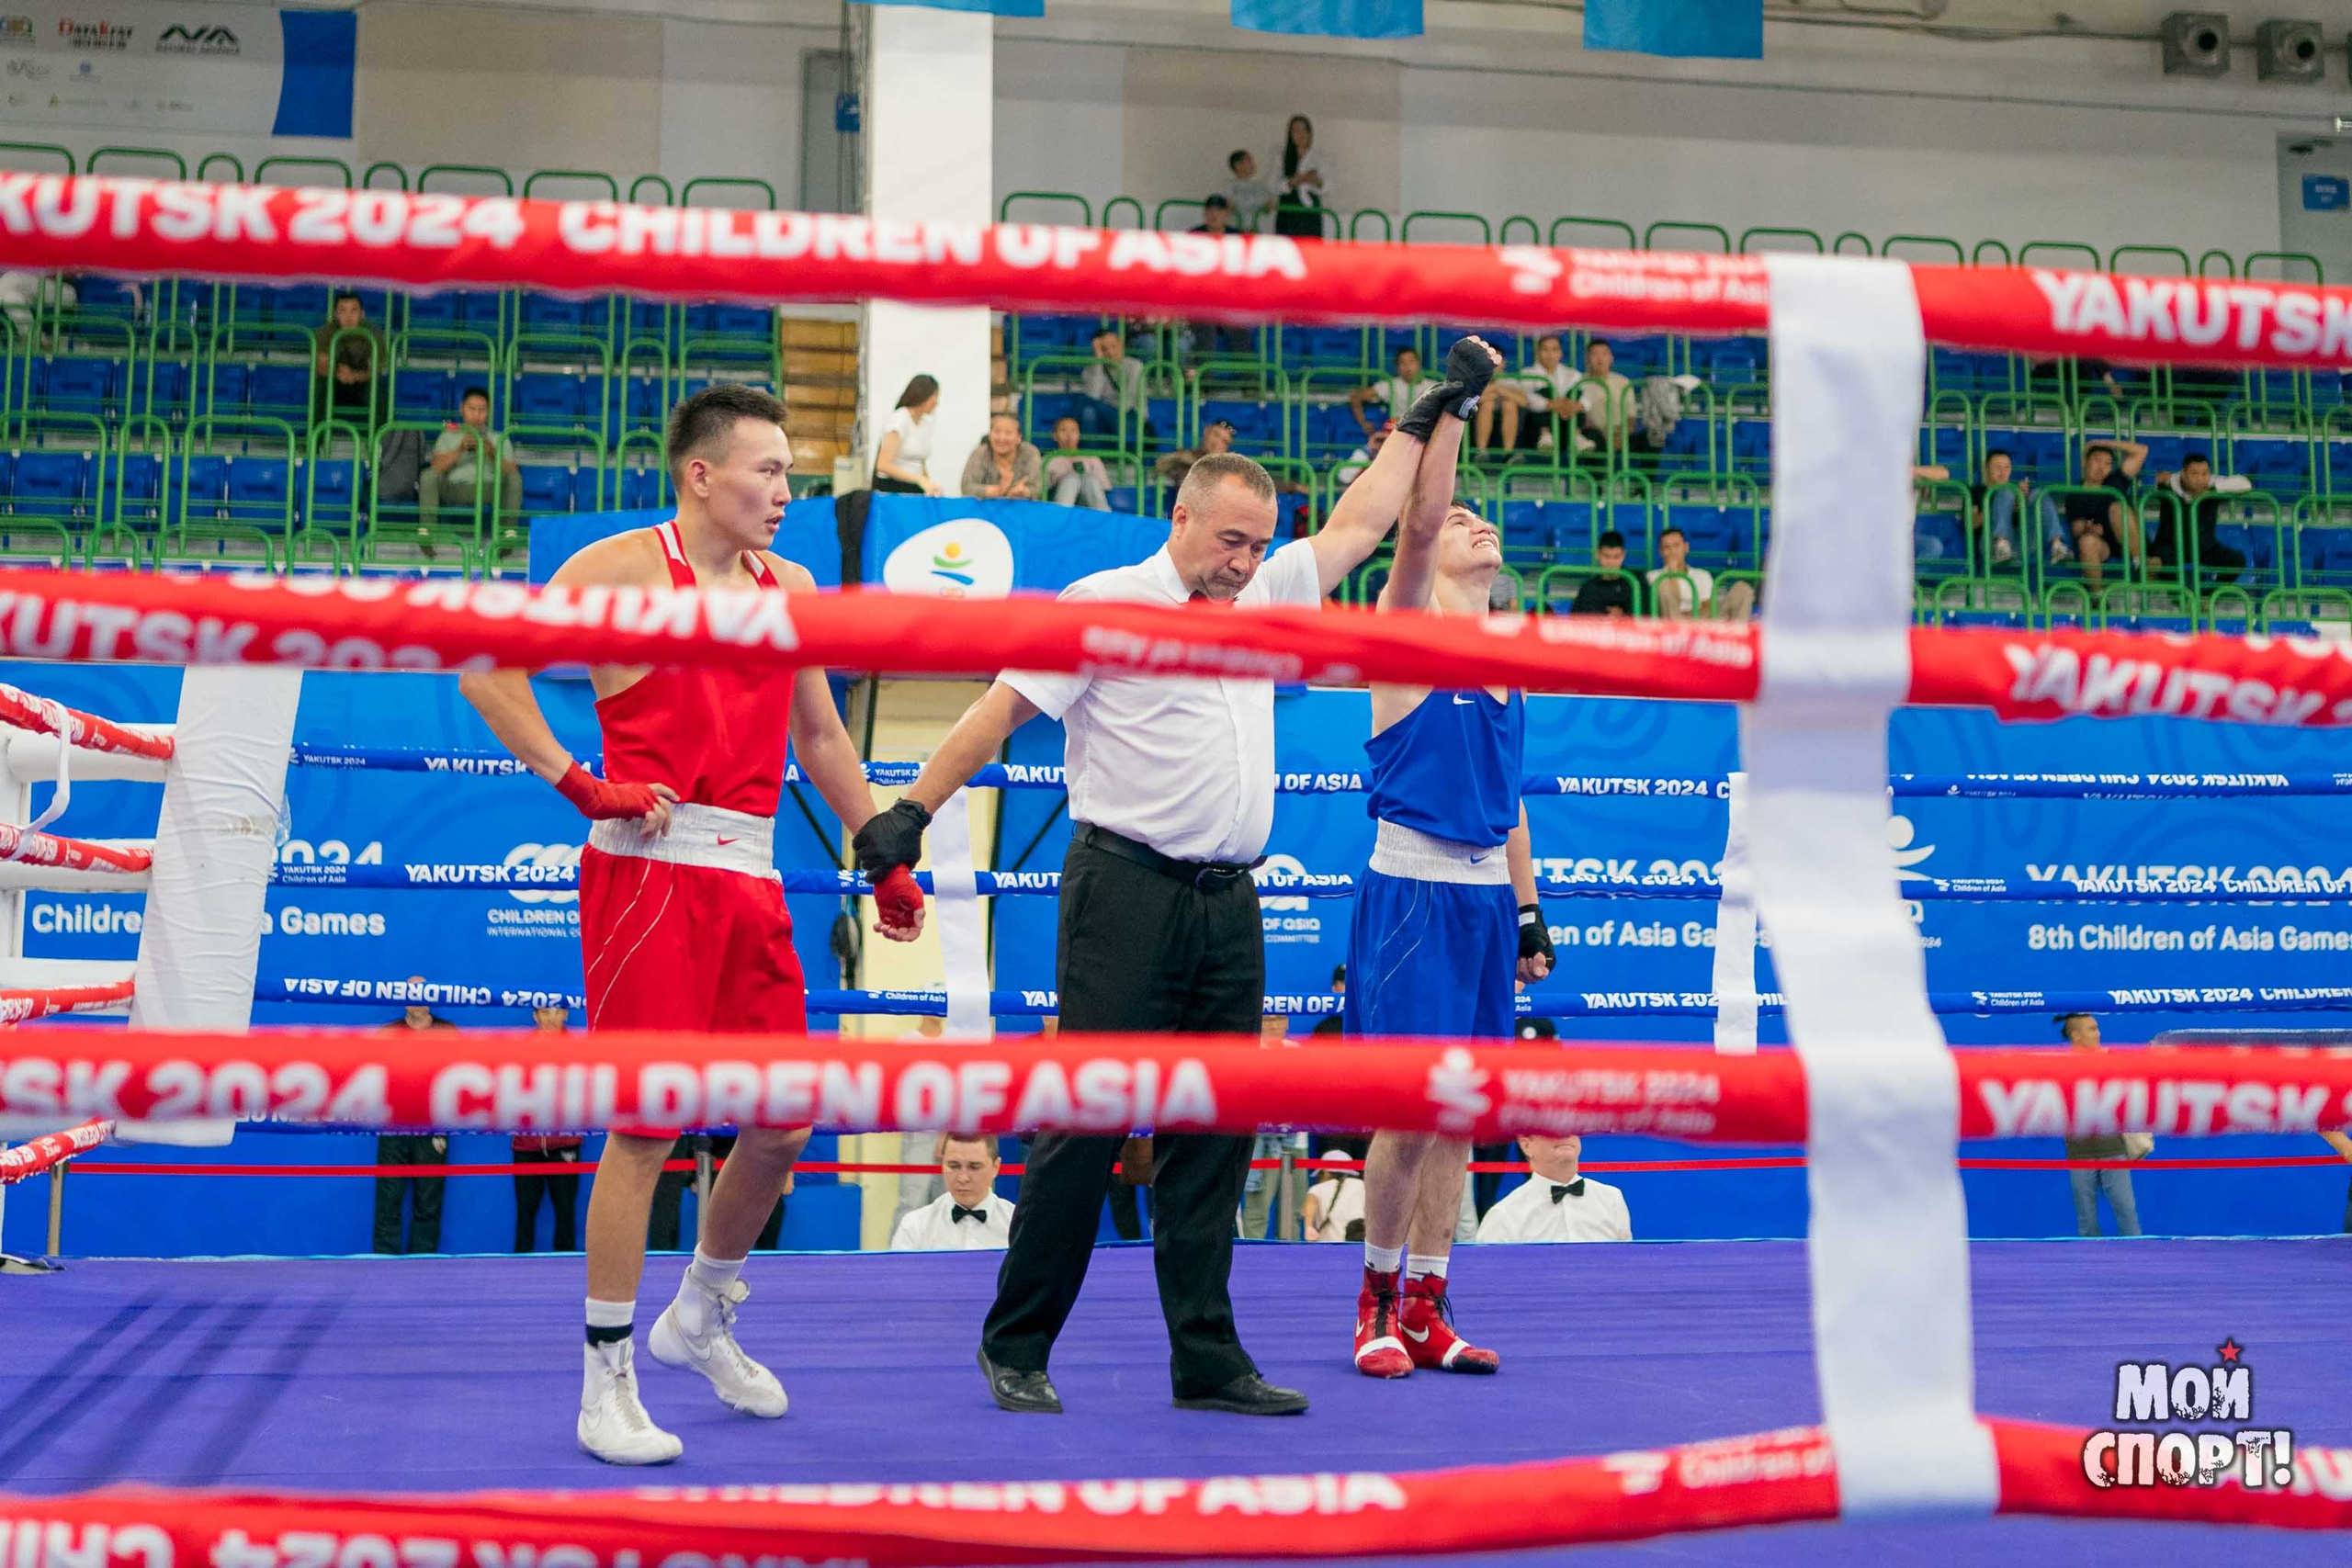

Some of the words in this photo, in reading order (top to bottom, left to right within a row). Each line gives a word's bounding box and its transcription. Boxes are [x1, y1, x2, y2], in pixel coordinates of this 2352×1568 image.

[289, 189, 526, 248] 2024
[558, 201, 984, 265] CHILDREN
[1108, 231, 1307, 279] ASIA
[874, 768, 912, 778] YAKUTSK
[1284, 773, 1312, 790] OF
[1314, 773, 1363, 790] ASIA
[1556, 776, 1651, 795] YAKUTSK
[1654, 779, 1709, 796] 2024
[283, 865, 322, 874] YAKUTSK
[323, 865, 346, 874] 2024
[404, 864, 512, 883] YAKUTSK
[514, 864, 576, 882] 2024
[2165, 879, 2217, 893] 2024
[280, 906, 386, 936] Games
[487, 908, 564, 925] CHILDREN
[487, 926, 568, 937] INTERNATIONAL
[1585, 920, 1615, 946] of
[1618, 921, 1677, 947] Asia
[2028, 924, 2073, 951] 8th
[2079, 924, 2184, 952] Children
[2189, 925, 2216, 951] of
[2220, 926, 2274, 952] Asia
[284, 978, 337, 995] ASIA
[340, 980, 370, 997] OF
[377, 981, 492, 1005] CHILDREN
[502, 990, 562, 1010] 2024
[885, 991, 918, 1002] Children
[1307, 996, 1334, 1012] OF
[1580, 992, 1679, 1009] YAKUTSK
[2108, 990, 2199, 1005] YAKUTSK
[2202, 988, 2254, 1003] 2024
[147, 1059, 391, 1123] 2024
[429, 1060, 884, 1131] CHILDREN
[896, 1060, 1009, 1131] OF
[1017, 1059, 1218, 1131] ASIA
[1978, 1077, 2330, 1138] YAKUTSK
